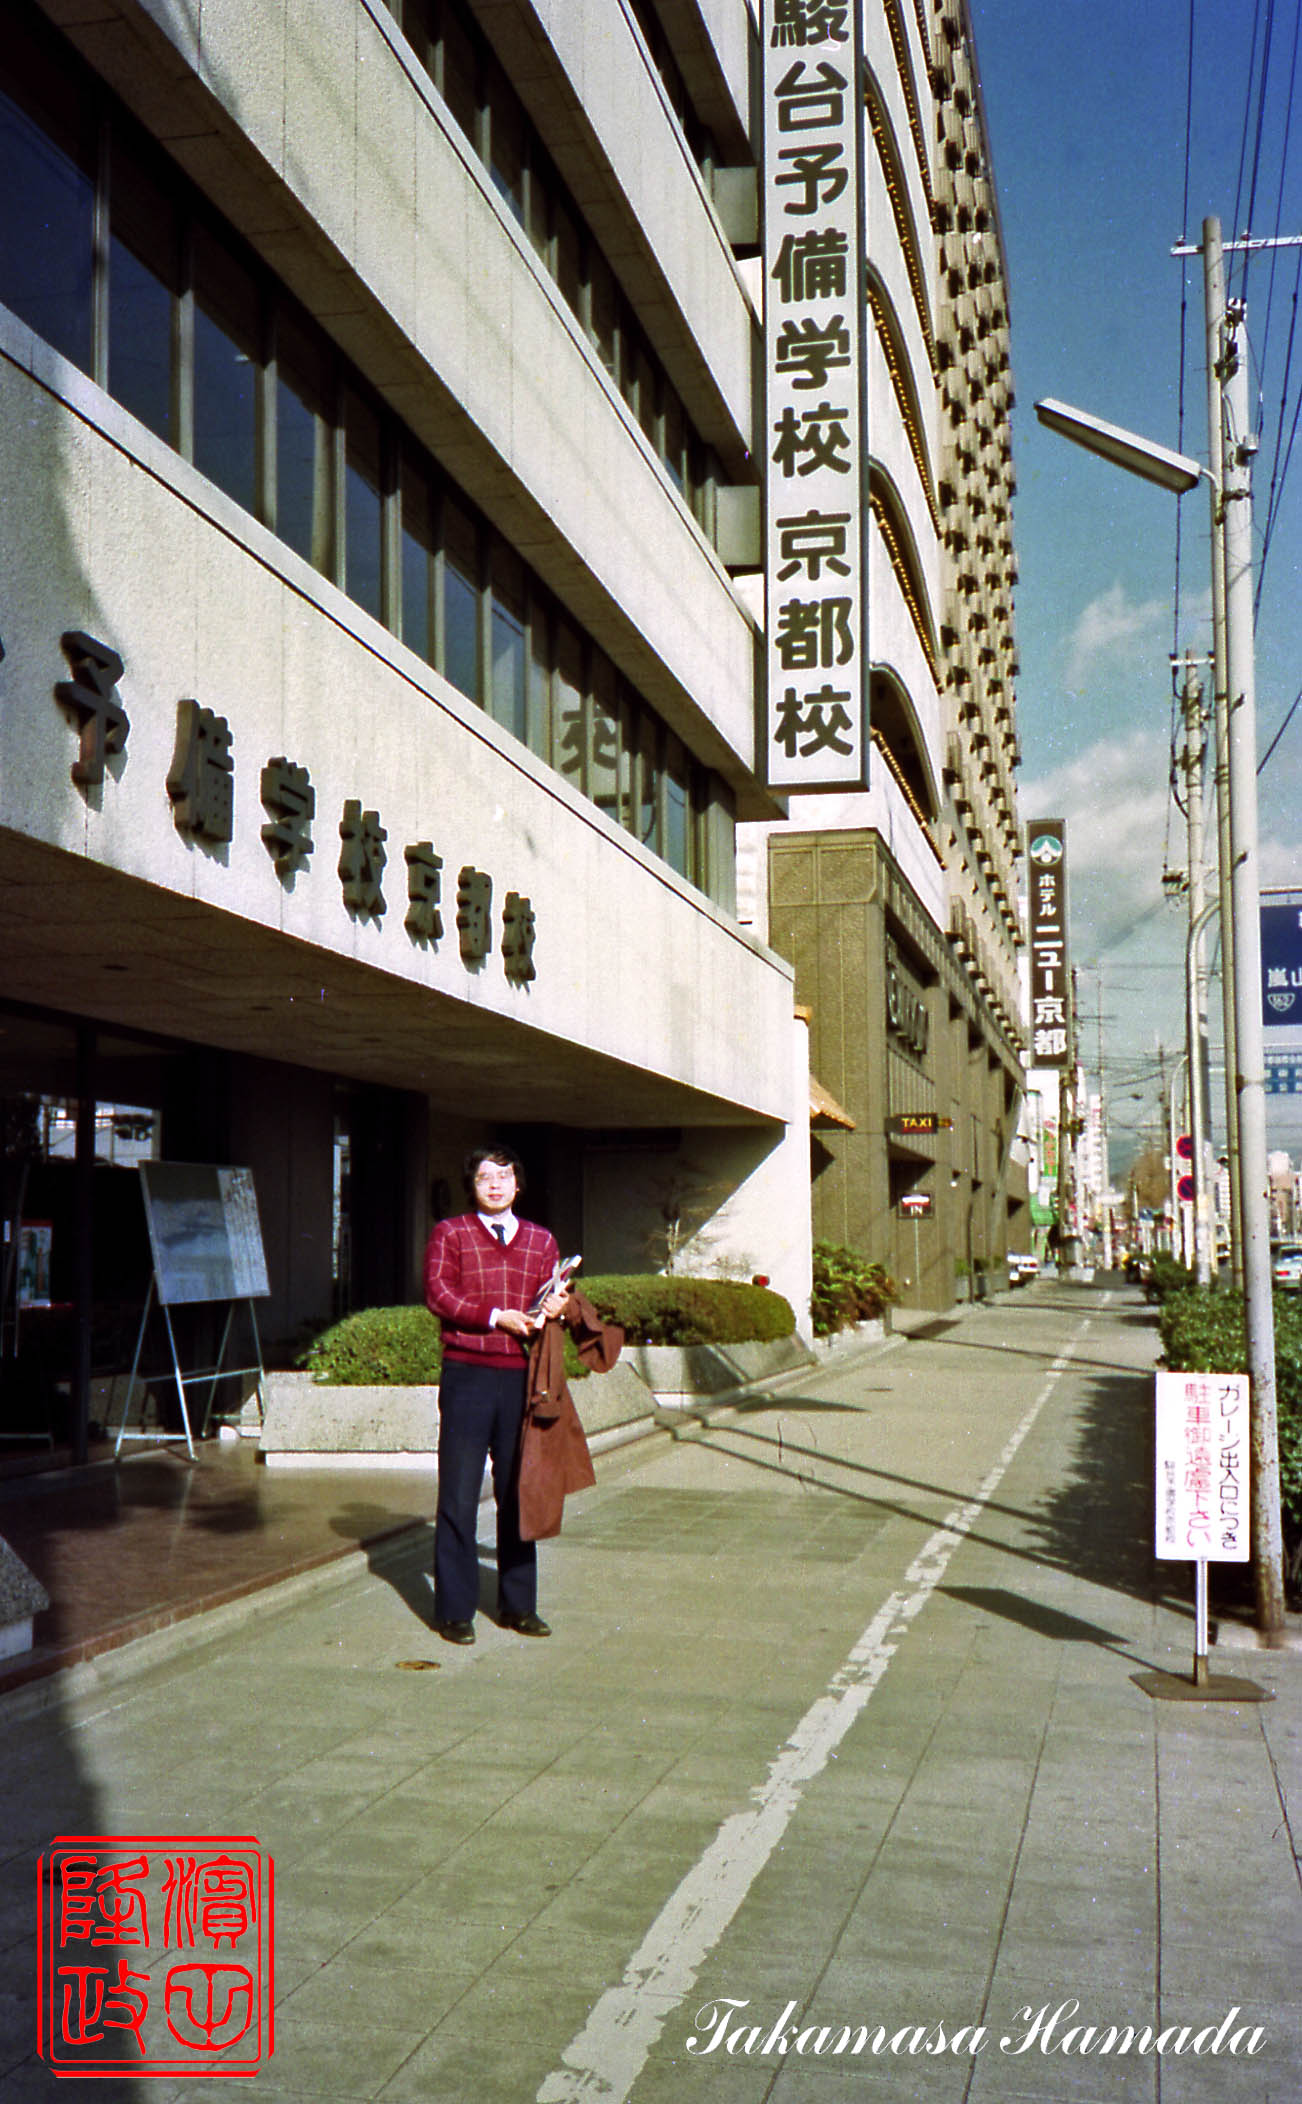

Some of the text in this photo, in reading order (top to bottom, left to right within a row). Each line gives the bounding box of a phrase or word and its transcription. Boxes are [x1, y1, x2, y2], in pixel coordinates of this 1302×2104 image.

[0, 630, 536, 981] 予備学校京都校
[902, 1118, 932, 1128] TAXI
